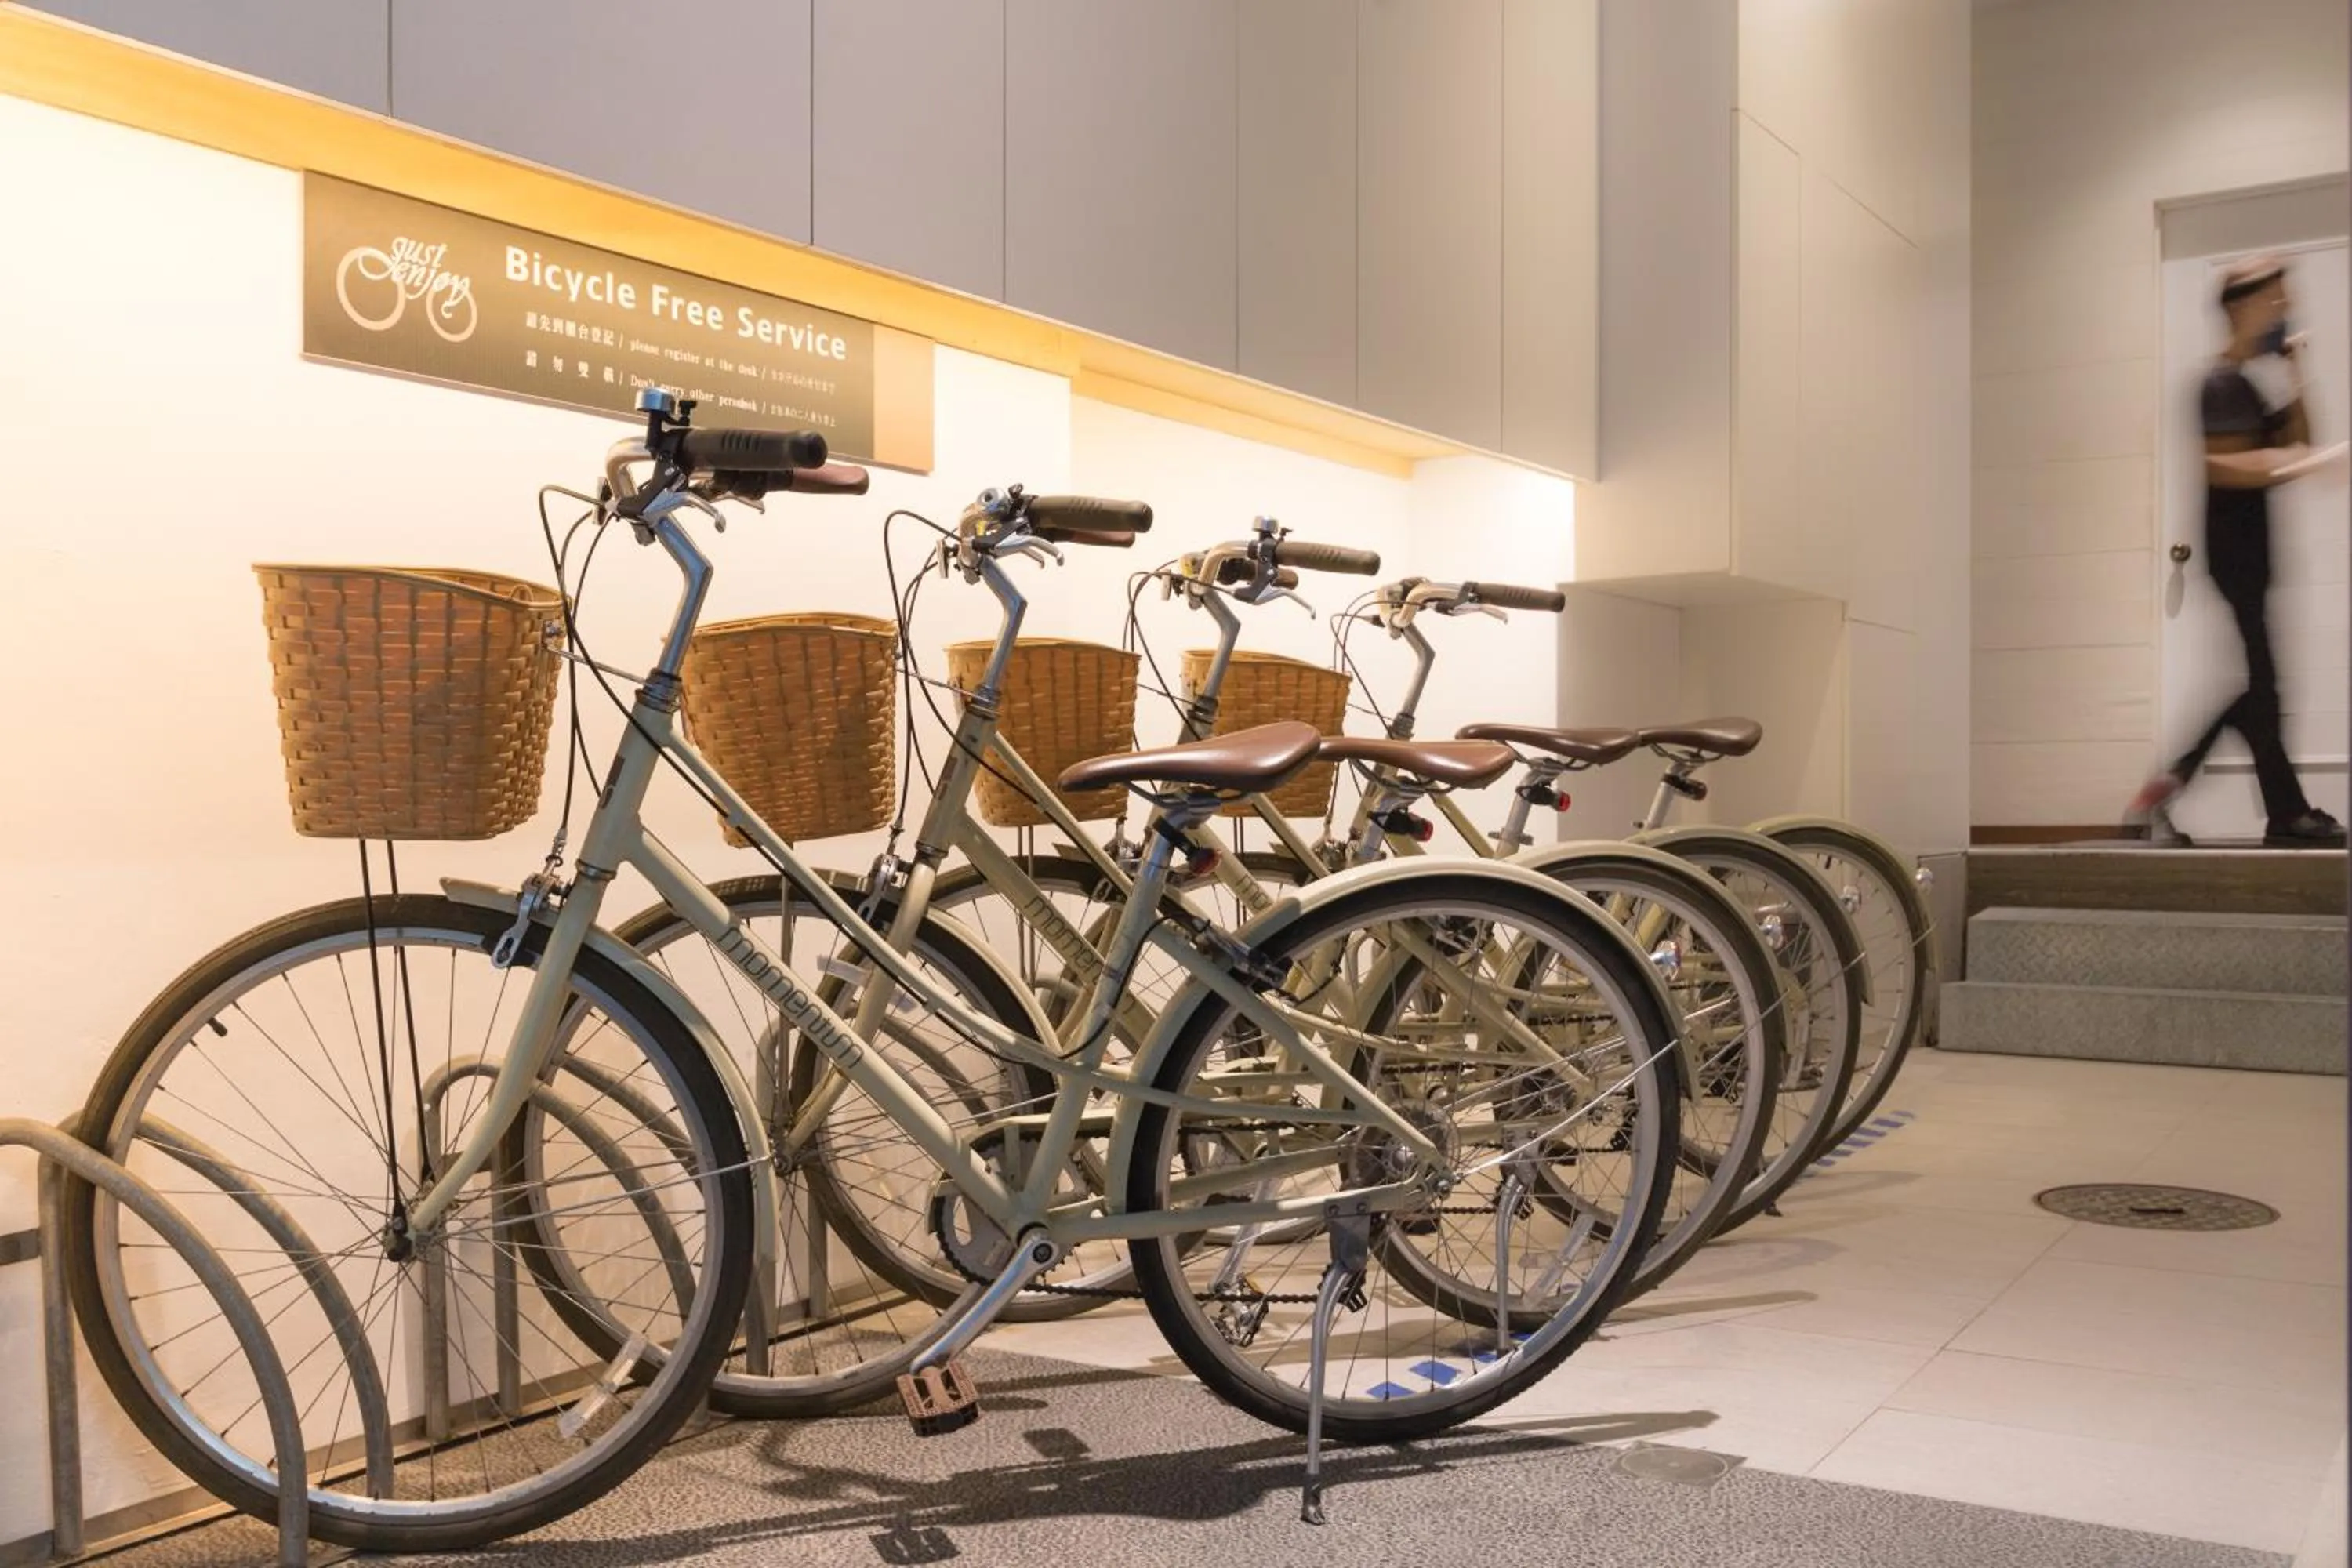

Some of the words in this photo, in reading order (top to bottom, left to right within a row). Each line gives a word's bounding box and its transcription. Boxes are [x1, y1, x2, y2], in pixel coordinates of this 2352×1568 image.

[505, 245, 637, 309] Bicycle
[652, 284, 724, 330] Free
[738, 307, 847, 361] Service
[717, 927, 864, 1069] momentum
